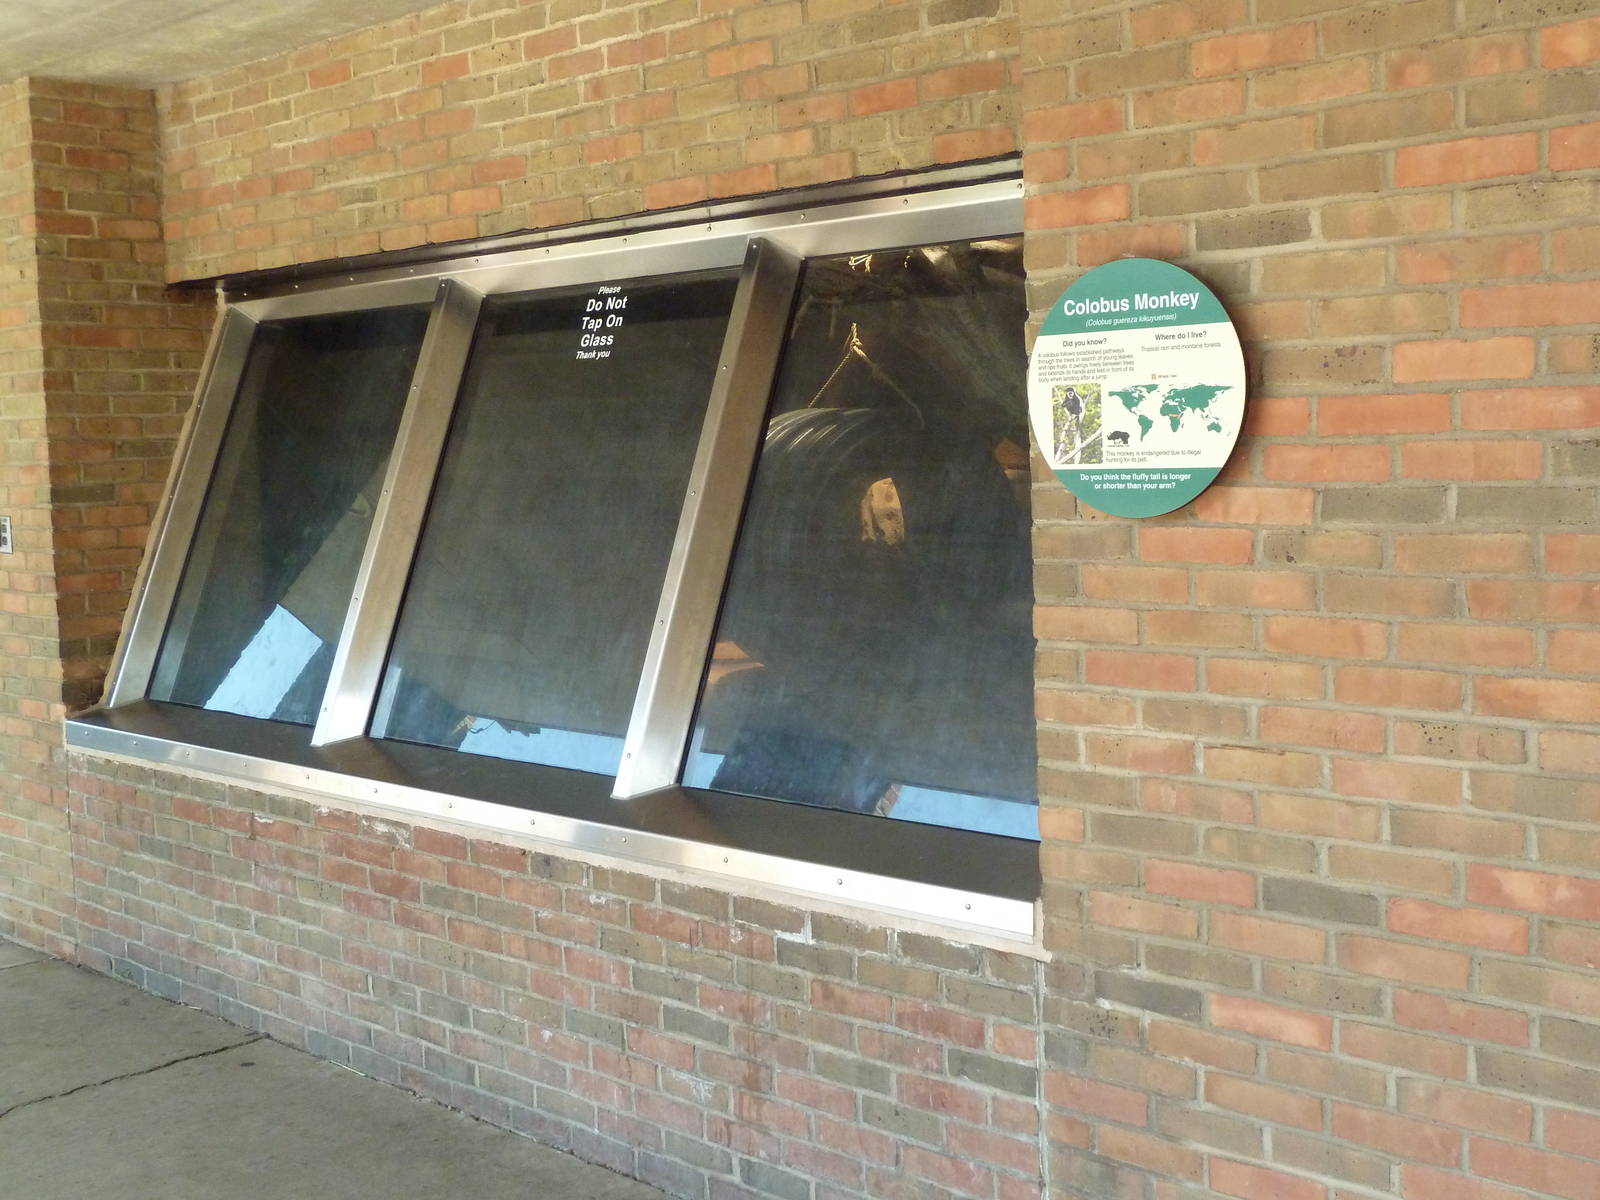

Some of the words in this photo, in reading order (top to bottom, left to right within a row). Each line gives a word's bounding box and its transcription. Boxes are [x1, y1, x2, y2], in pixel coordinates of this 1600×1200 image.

[598, 286, 622, 295] Please
[586, 298, 603, 312] Do
[605, 296, 628, 310] Not
[1063, 297, 1130, 316] Colobus
[1134, 290, 1200, 310] Monkey
[582, 316, 603, 332] Tap
[606, 314, 623, 327] On
[1085, 318, 1113, 328] (Colobus
[580, 333, 614, 347] Glass
[1155, 333, 1176, 341] Where
[1191, 330, 1207, 338] live?
[1074, 340, 1086, 348] you
[1087, 337, 1107, 346] know?
[576, 350, 597, 360] Thank
[596, 350, 611, 361] you
[1140, 449, 1170, 457] endangered
[1090, 474, 1102, 482] you
[1132, 472, 1149, 482] fluffy
[1150, 472, 1160, 480] tail
[1161, 472, 1169, 480] is
[1169, 472, 1191, 481] longer
[1142, 482, 1157, 491] your
[1158, 481, 1176, 489] arm?
